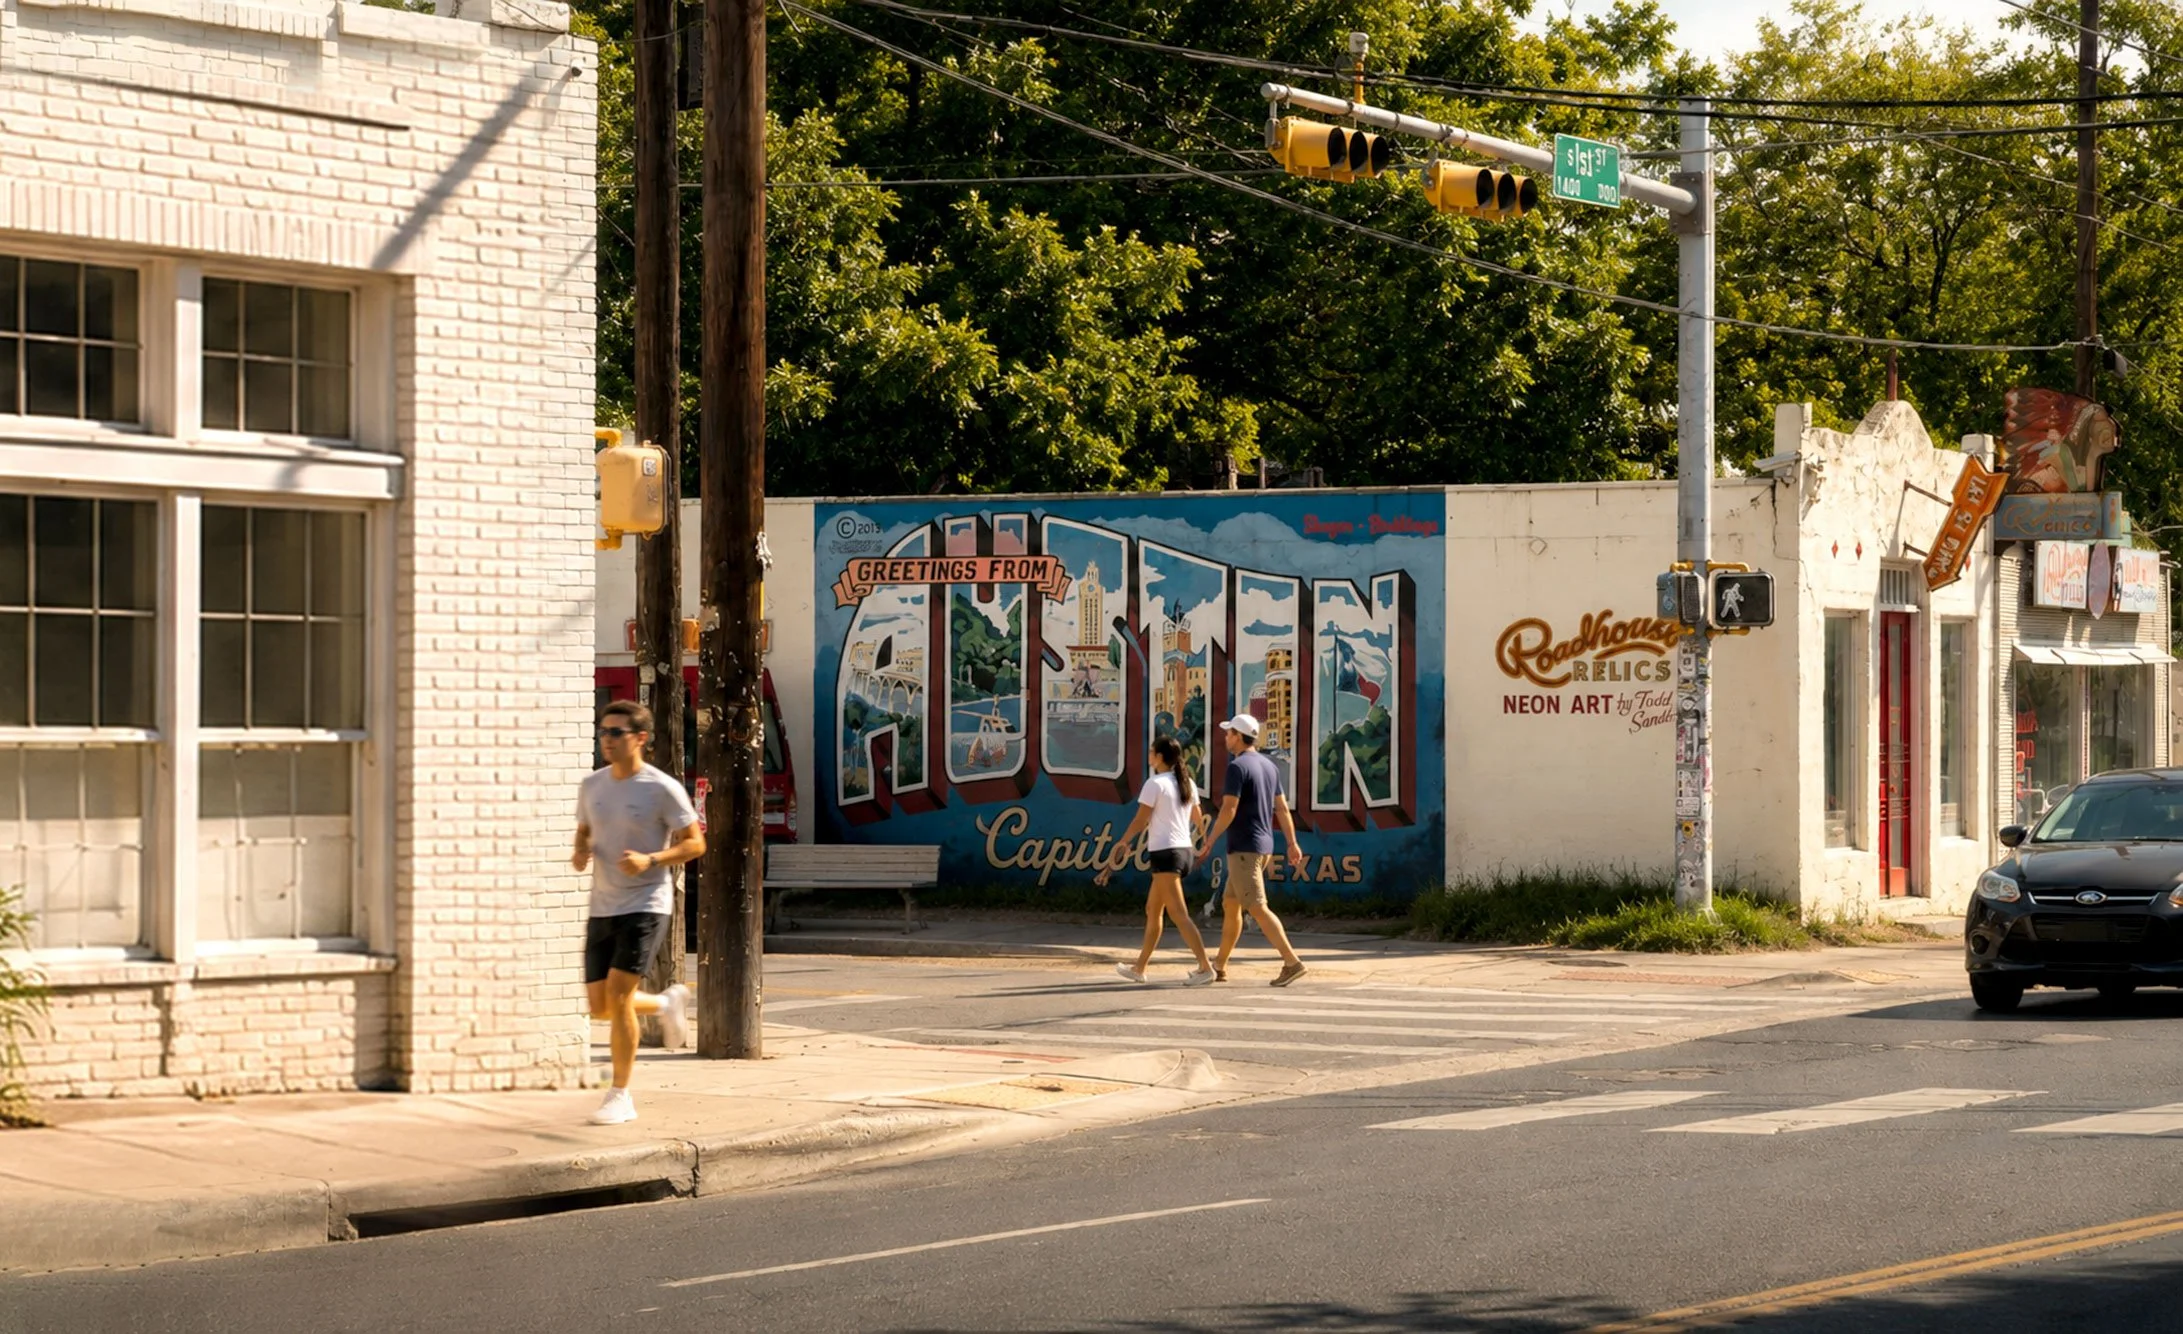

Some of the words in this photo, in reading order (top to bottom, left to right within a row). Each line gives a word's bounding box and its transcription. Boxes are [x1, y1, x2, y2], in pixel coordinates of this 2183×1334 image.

[1557, 175, 1581, 197] 1400
[857, 560, 977, 582] GREETINGS
[988, 559, 1048, 581] FROM
[1572, 659, 1671, 682] RELICS
[1503, 694, 1560, 714] NEON
[1571, 694, 1613, 714] ART
[1616, 692, 1633, 717] by
[1634, 689, 1674, 710] Todd
